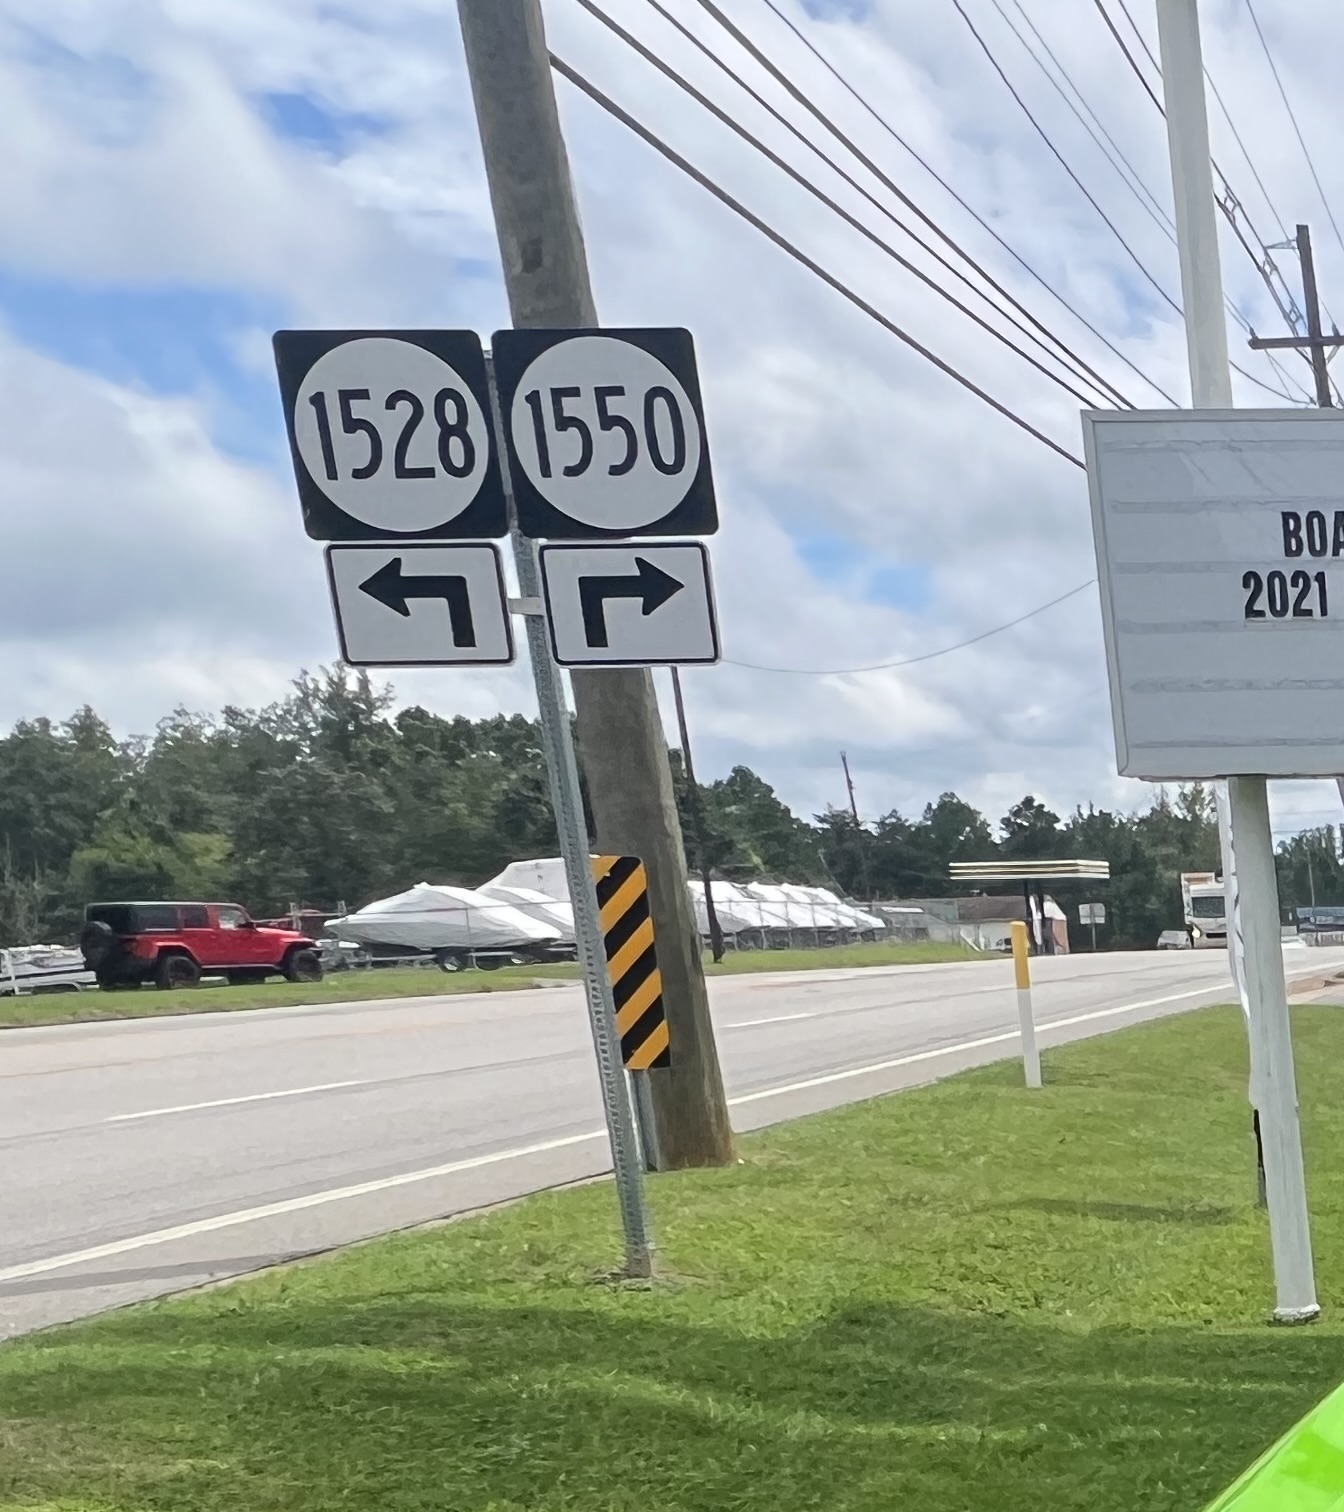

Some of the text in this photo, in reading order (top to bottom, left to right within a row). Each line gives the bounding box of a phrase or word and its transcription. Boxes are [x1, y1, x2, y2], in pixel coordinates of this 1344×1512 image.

[308, 387, 476, 481] 1528
[524, 385, 686, 478] 1550
[1242, 570, 1328, 619] 2021
